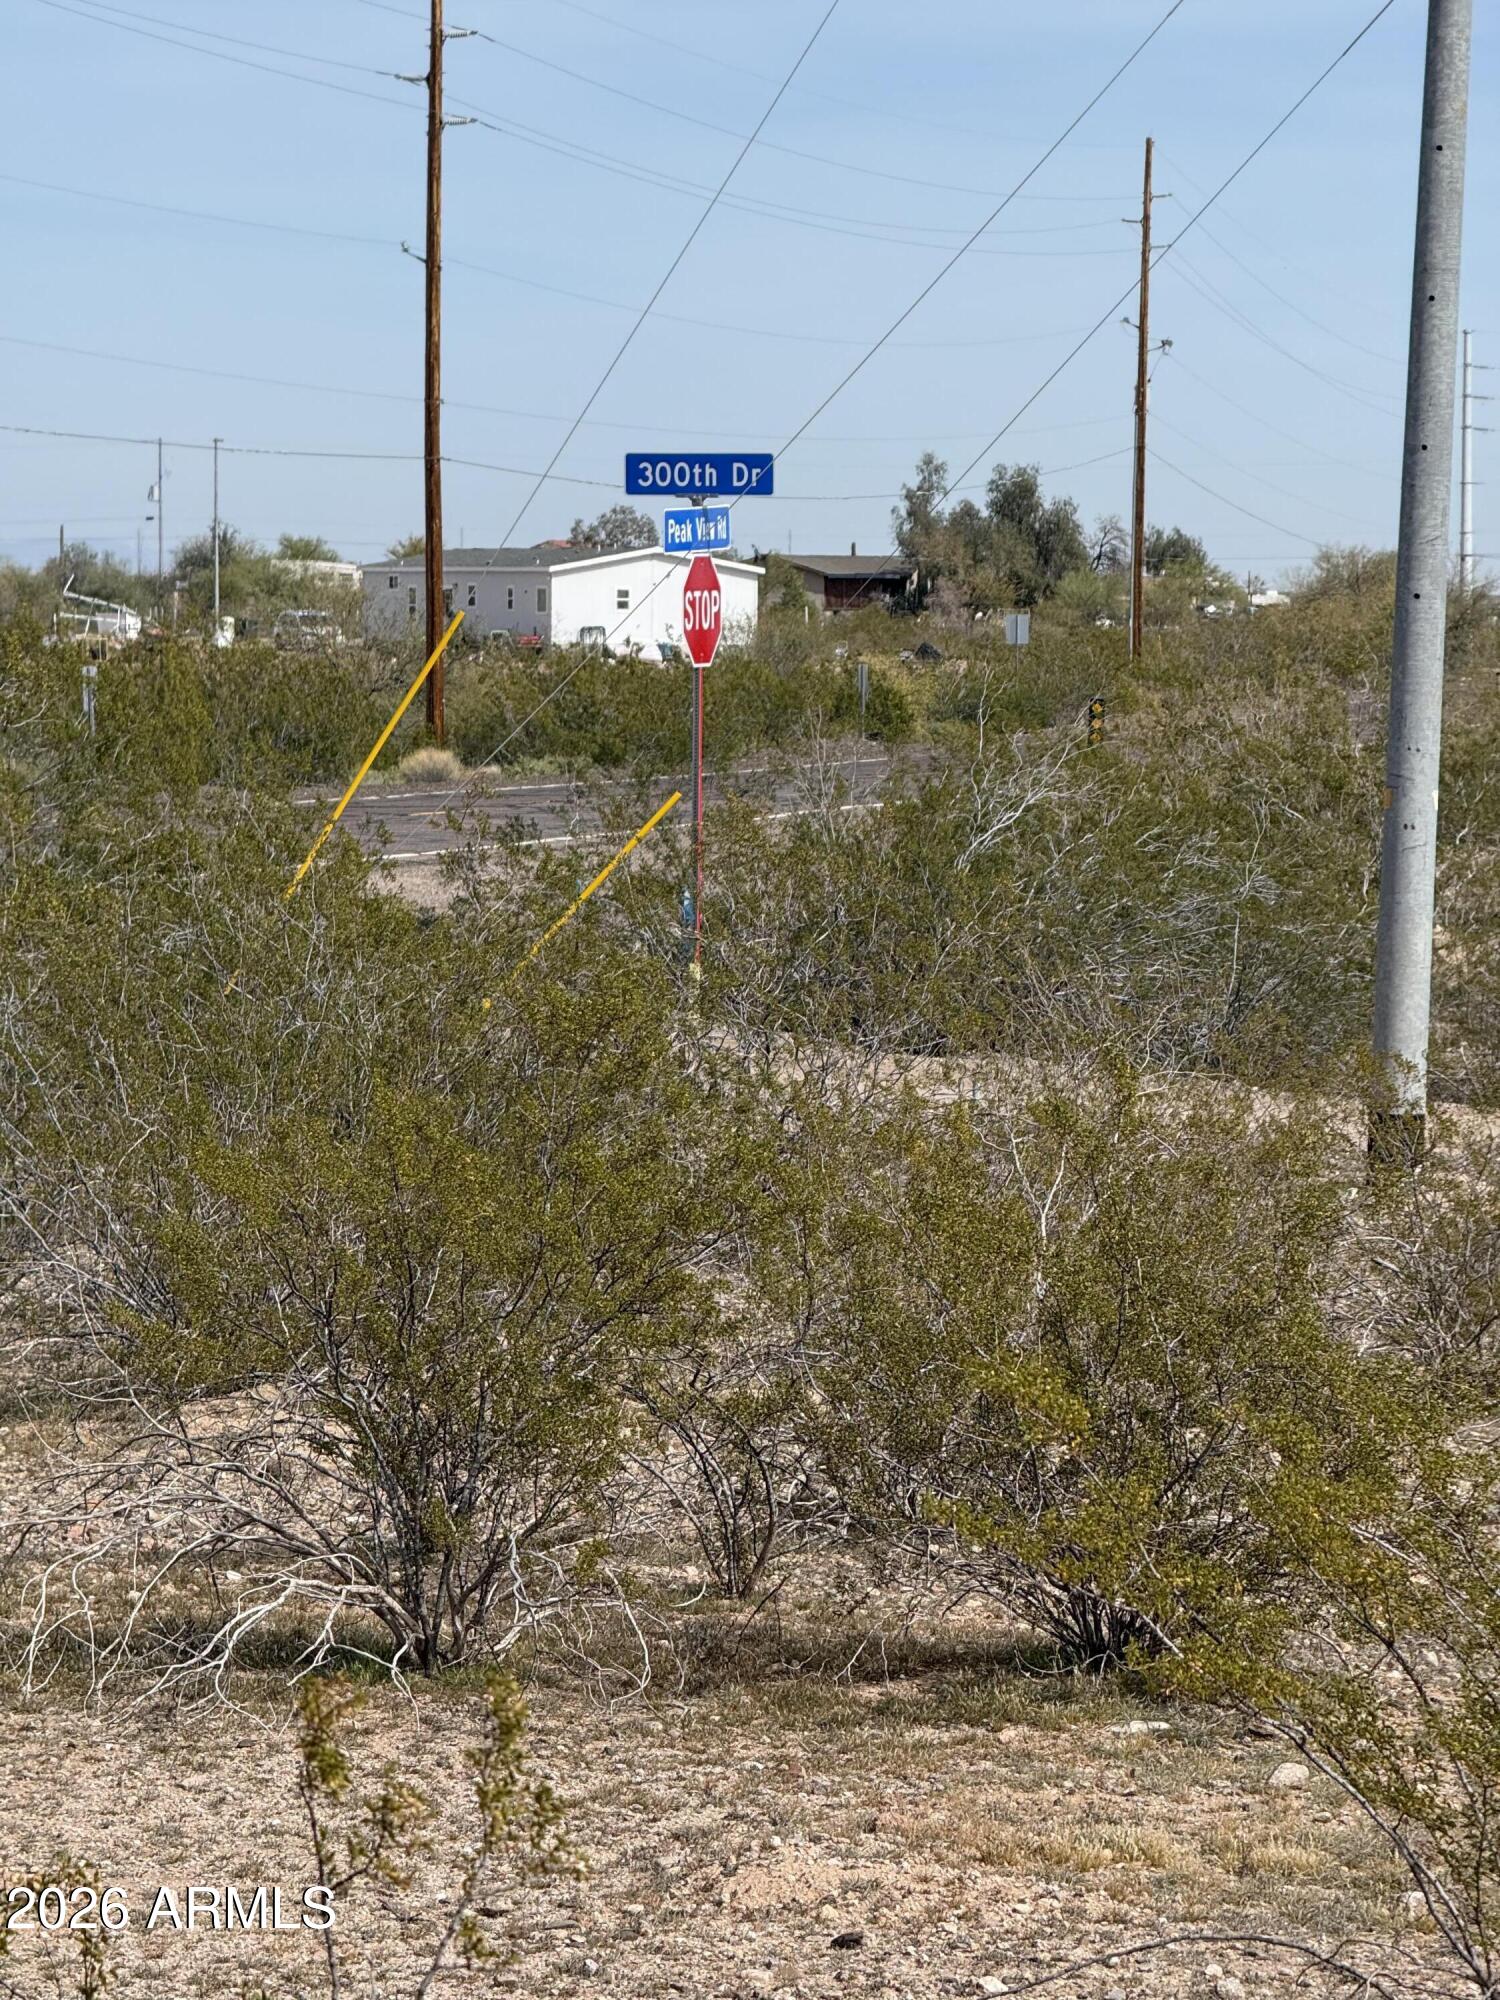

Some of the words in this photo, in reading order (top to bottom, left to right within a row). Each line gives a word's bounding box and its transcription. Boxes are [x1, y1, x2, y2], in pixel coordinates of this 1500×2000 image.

[638, 462, 717, 487] 300th
[732, 462, 762, 487] Dr
[668, 518, 693, 544] Peak
[717, 515, 727, 540] Rd
[684, 590, 720, 631] STOP
